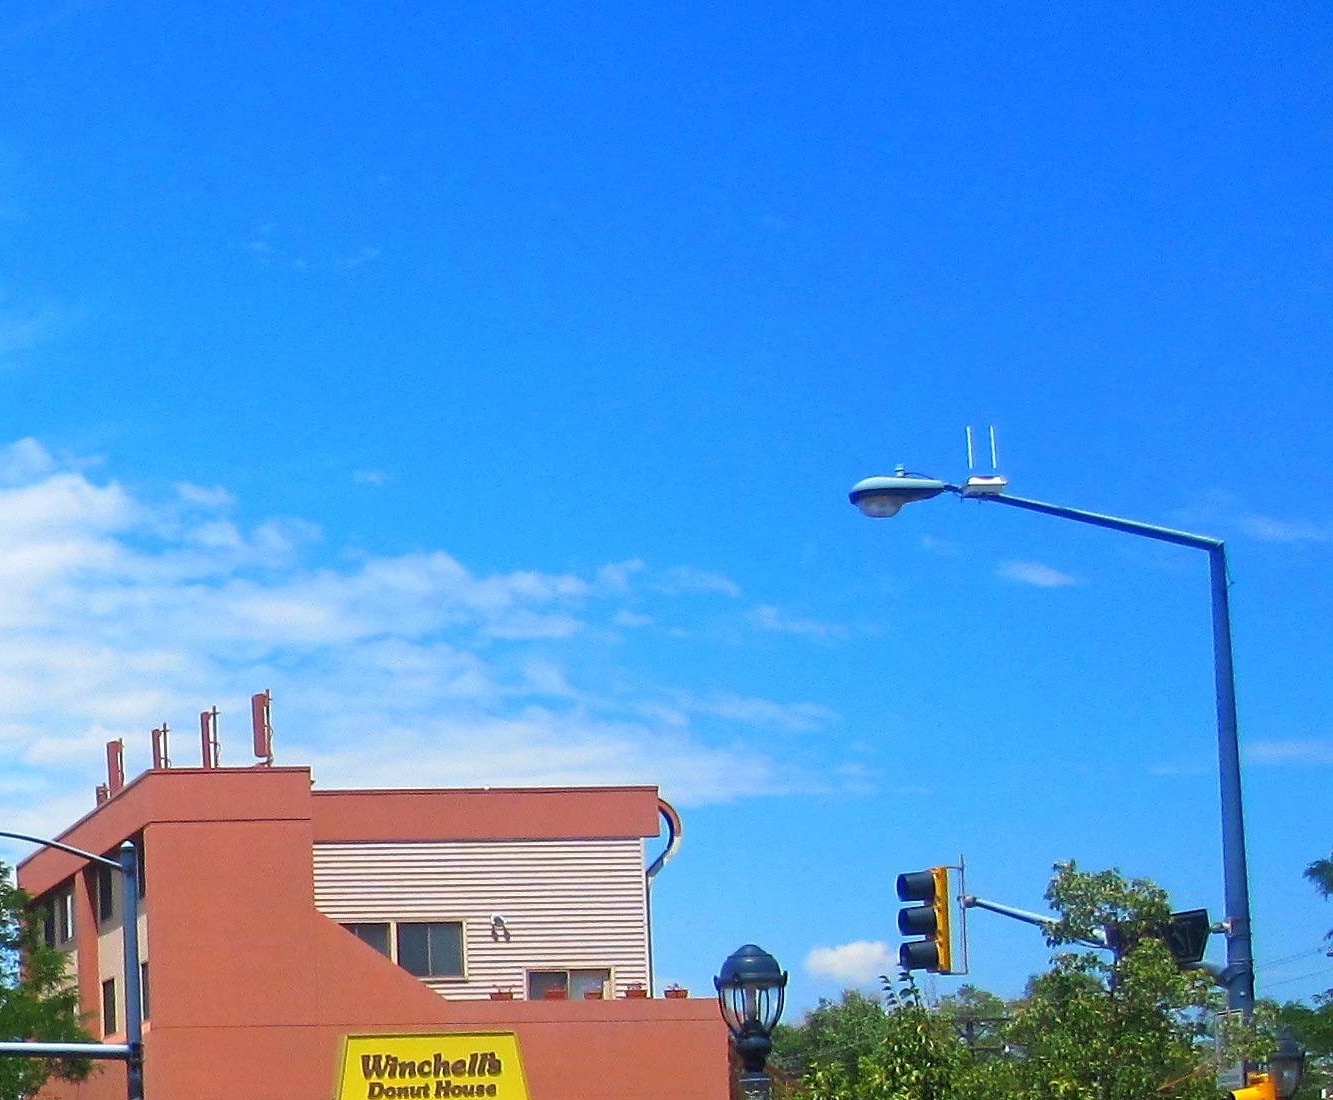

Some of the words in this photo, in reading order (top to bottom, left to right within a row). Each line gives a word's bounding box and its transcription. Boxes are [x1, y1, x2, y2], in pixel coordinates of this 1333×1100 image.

[361, 1051, 502, 1079] Winchell's
[367, 1081, 430, 1100] Donut
[434, 1080, 497, 1099] House
